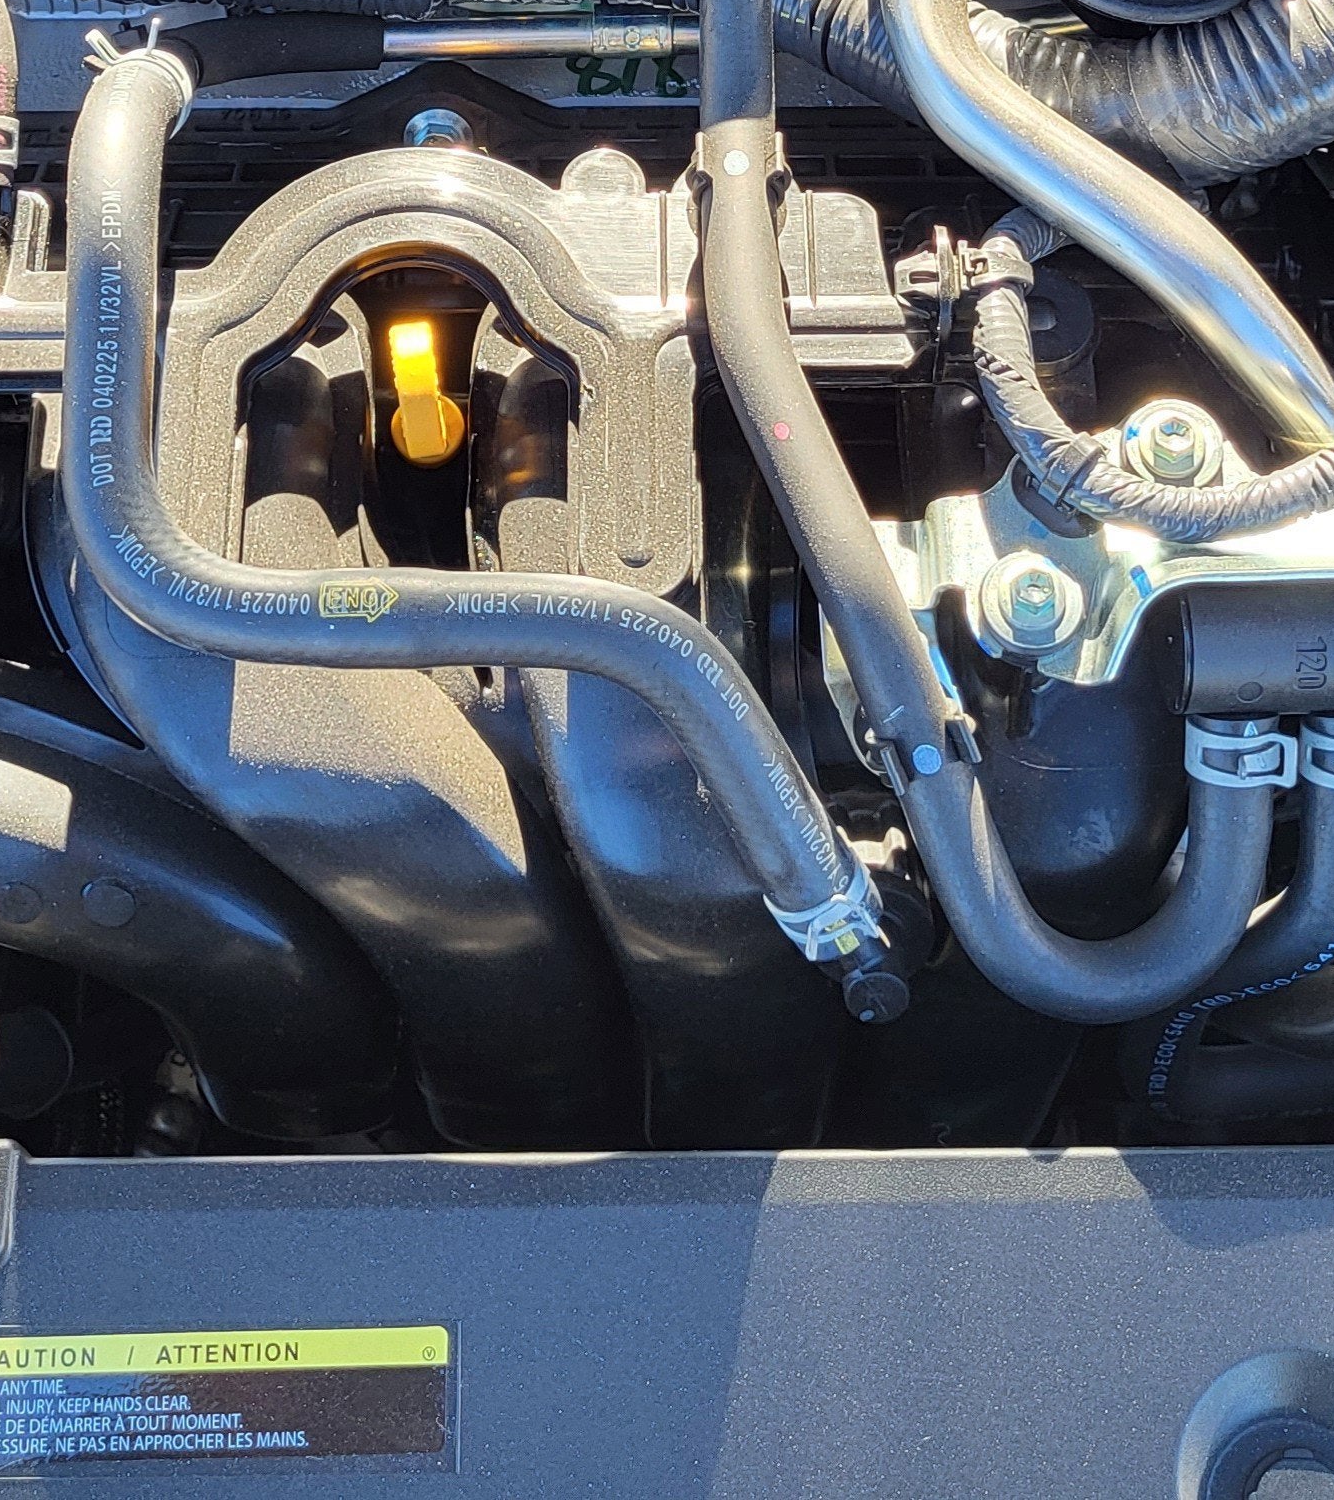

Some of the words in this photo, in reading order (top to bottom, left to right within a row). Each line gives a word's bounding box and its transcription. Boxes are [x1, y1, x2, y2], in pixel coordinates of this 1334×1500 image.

[102, 176, 122, 253] >EPDM<
[93, 344, 123, 409] 040225
[89, 453, 116, 488] DOT
[238, 589, 312, 616] 040225
[444, 592, 521, 615] >EPDM<
[618, 608, 695, 658] 040225
[1294, 634, 1329, 691] 120
[720, 681, 750, 721] DOT
[126, 1345, 135, 1366] /
[155, 1341, 300, 1365] ATTENTION
[0, 1379, 28, 1396] ANY
[27, 1378, 67, 1395] TIME.
[5, 1398, 55, 1417] INJURY,
[57, 1397, 91, 1414] KEEP
[93, 1396, 142, 1413] HANDS
[144, 1394, 192, 1412] CLEAR.
[5, 1419, 25, 1435] DE
[28, 1414, 111, 1434] DÉMARRER
[113, 1411, 125, 1431] À
[127, 1413, 169, 1431] TOUT
[171, 1412, 244, 1430] MOMENT.
[54, 1436, 76, 1452] NE
[79, 1435, 107, 1452] PAS
[109, 1434, 133, 1451] EN
[134, 1432, 224, 1451] APPROCHER
[227, 1431, 254, 1448] LES
[255, 1430, 310, 1448] MAINS.
